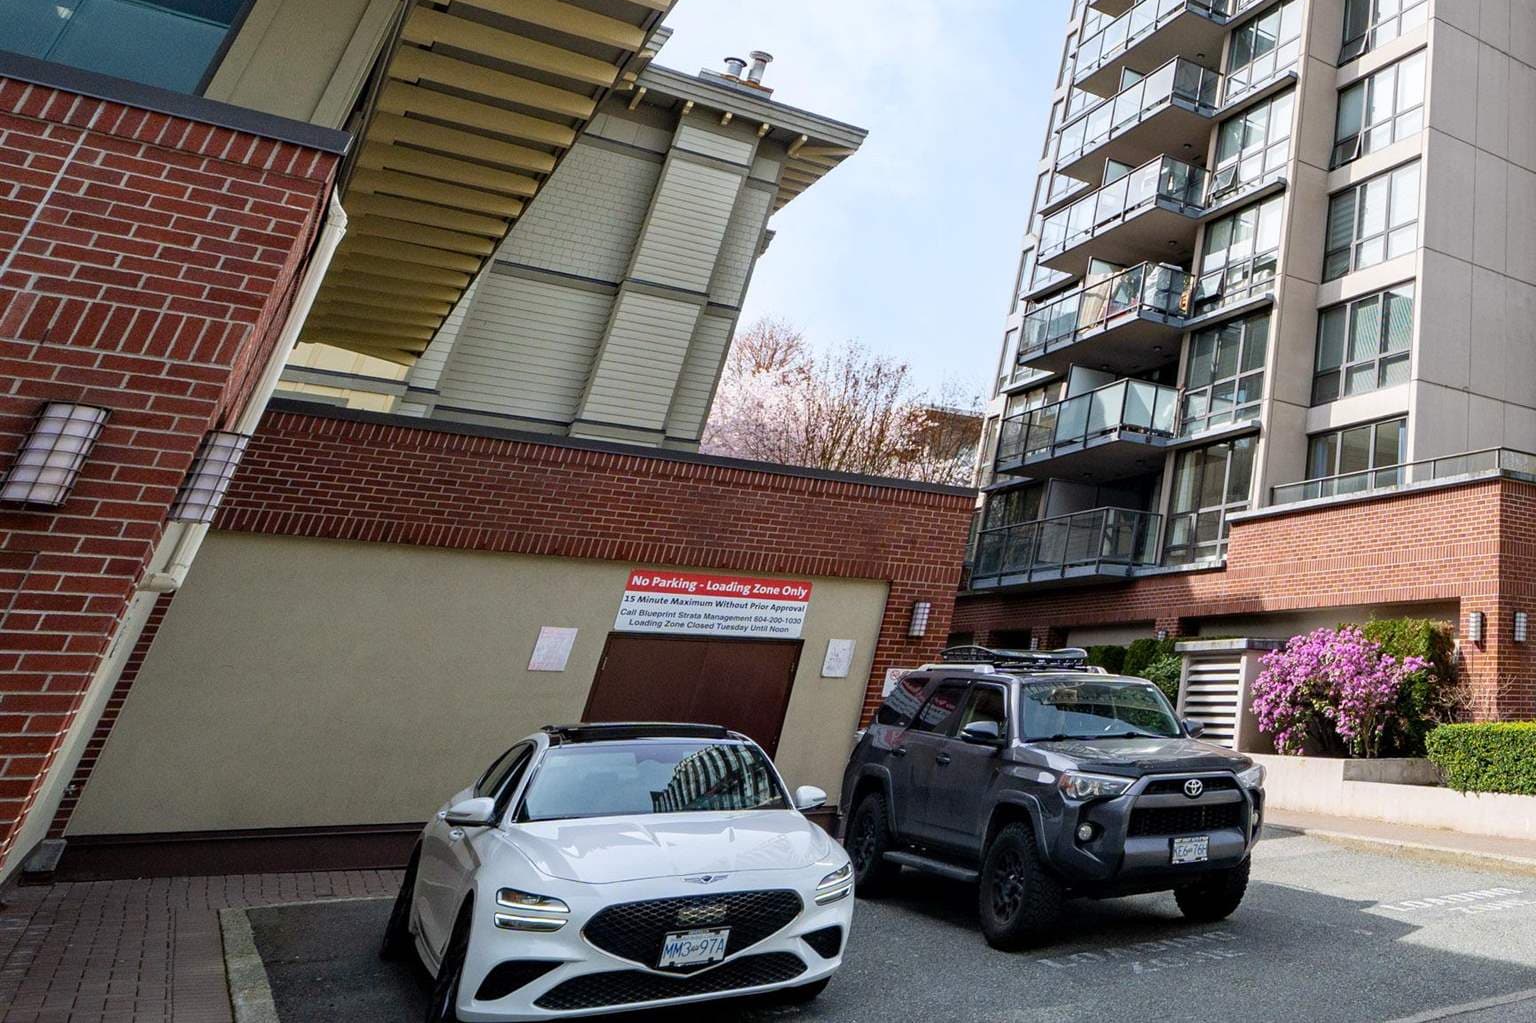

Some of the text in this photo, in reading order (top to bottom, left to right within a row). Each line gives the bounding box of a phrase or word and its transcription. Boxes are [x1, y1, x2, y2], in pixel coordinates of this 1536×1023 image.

[632, 575, 650, 586] No
[651, 576, 698, 592] Parking
[706, 580, 751, 595] Loading
[753, 584, 780, 595] Zone
[782, 586, 808, 599] Only
[637, 595, 669, 605] Minute
[670, 597, 713, 607] Maximum
[715, 600, 748, 609] Without
[750, 602, 769, 610] Prior
[770, 604, 805, 613] Approval
[620, 608, 637, 616] Call
[639, 609, 676, 619] Blueprint
[678, 611, 701, 619] Strata
[703, 612, 752, 622] Management
[629, 618, 663, 628] Loading
[686, 621, 714, 629] Closed
[717, 623, 749, 632] Tuesday
[750, 624, 768, 632] Until
[769, 625, 789, 633] Noon
[663, 938, 724, 959] MM3 97A
